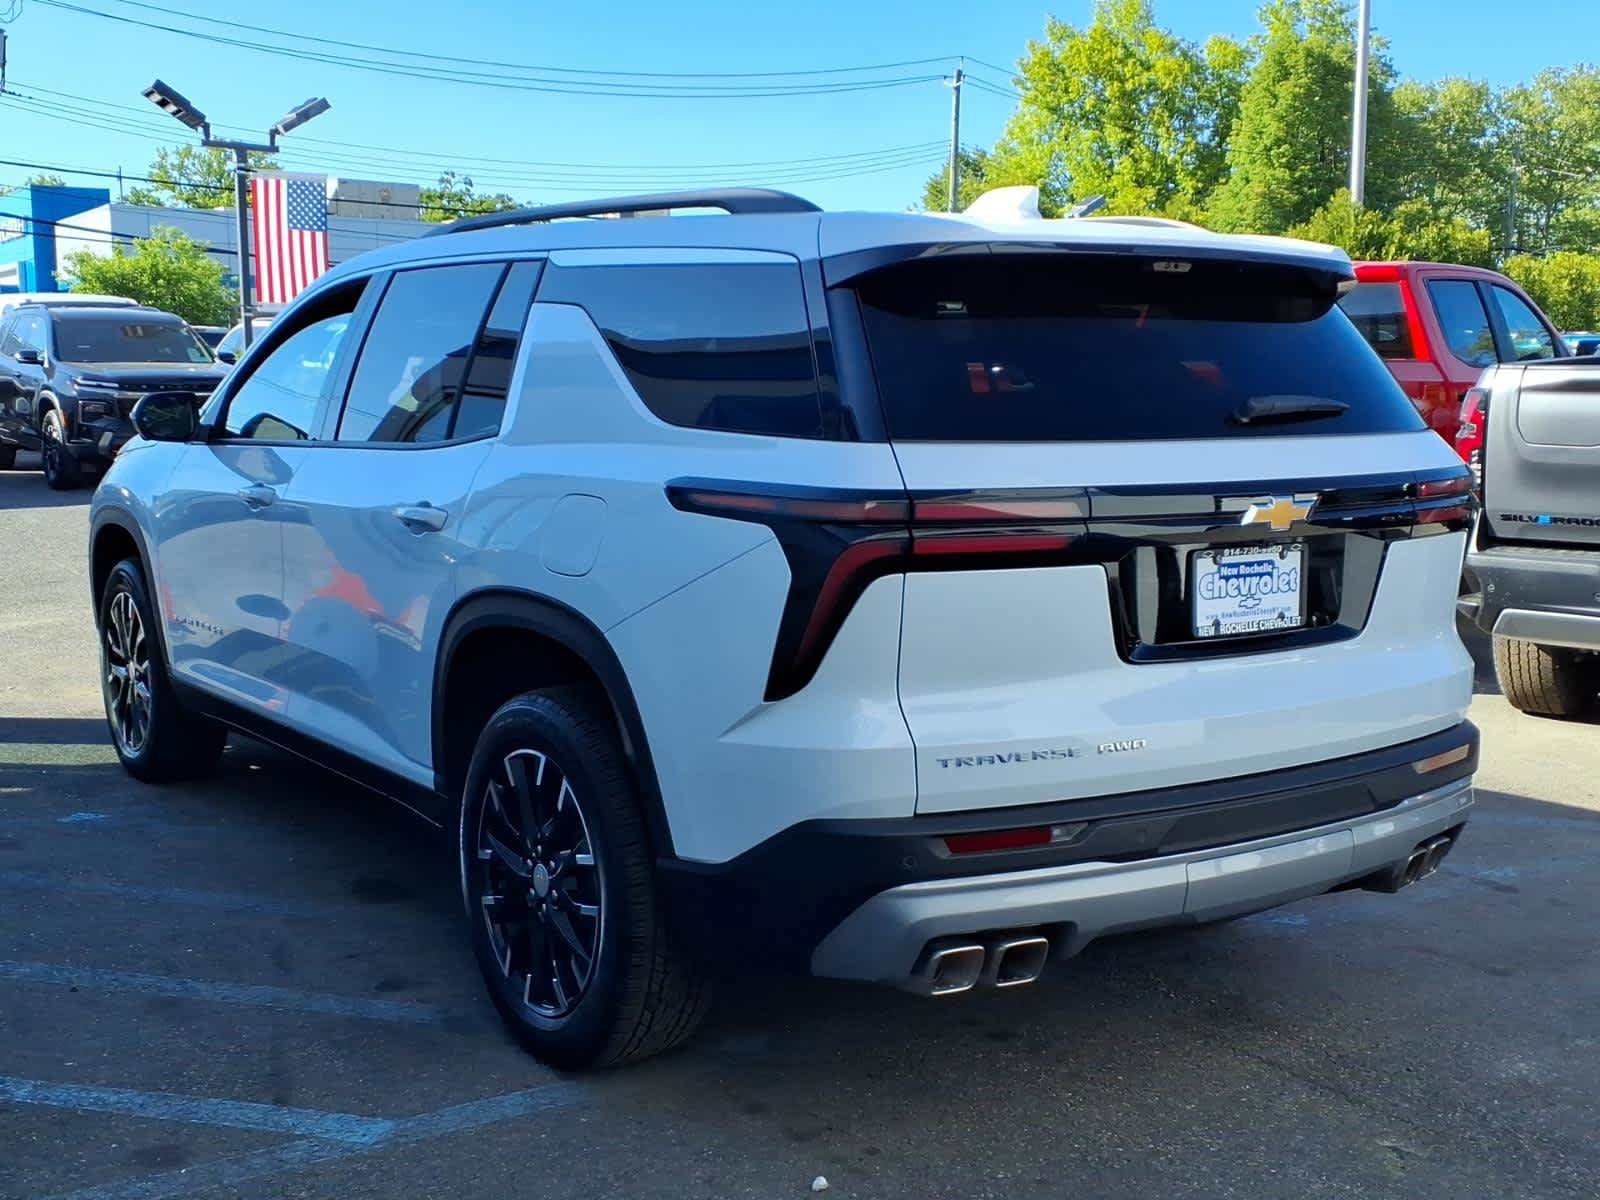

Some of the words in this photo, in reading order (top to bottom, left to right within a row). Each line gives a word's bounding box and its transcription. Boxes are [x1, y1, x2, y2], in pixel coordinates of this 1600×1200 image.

[1220, 566, 1239, 576] New
[1240, 562, 1273, 575] Rochelle
[1199, 567, 1298, 600] Chevrolet
[1199, 625, 1215, 637] NEW
[1220, 619, 1259, 634] ROCHELLE
[1259, 616, 1301, 630] CHEVROLET
[936, 747, 1080, 768] TRAVERSE
[1097, 739, 1147, 754] AWD
